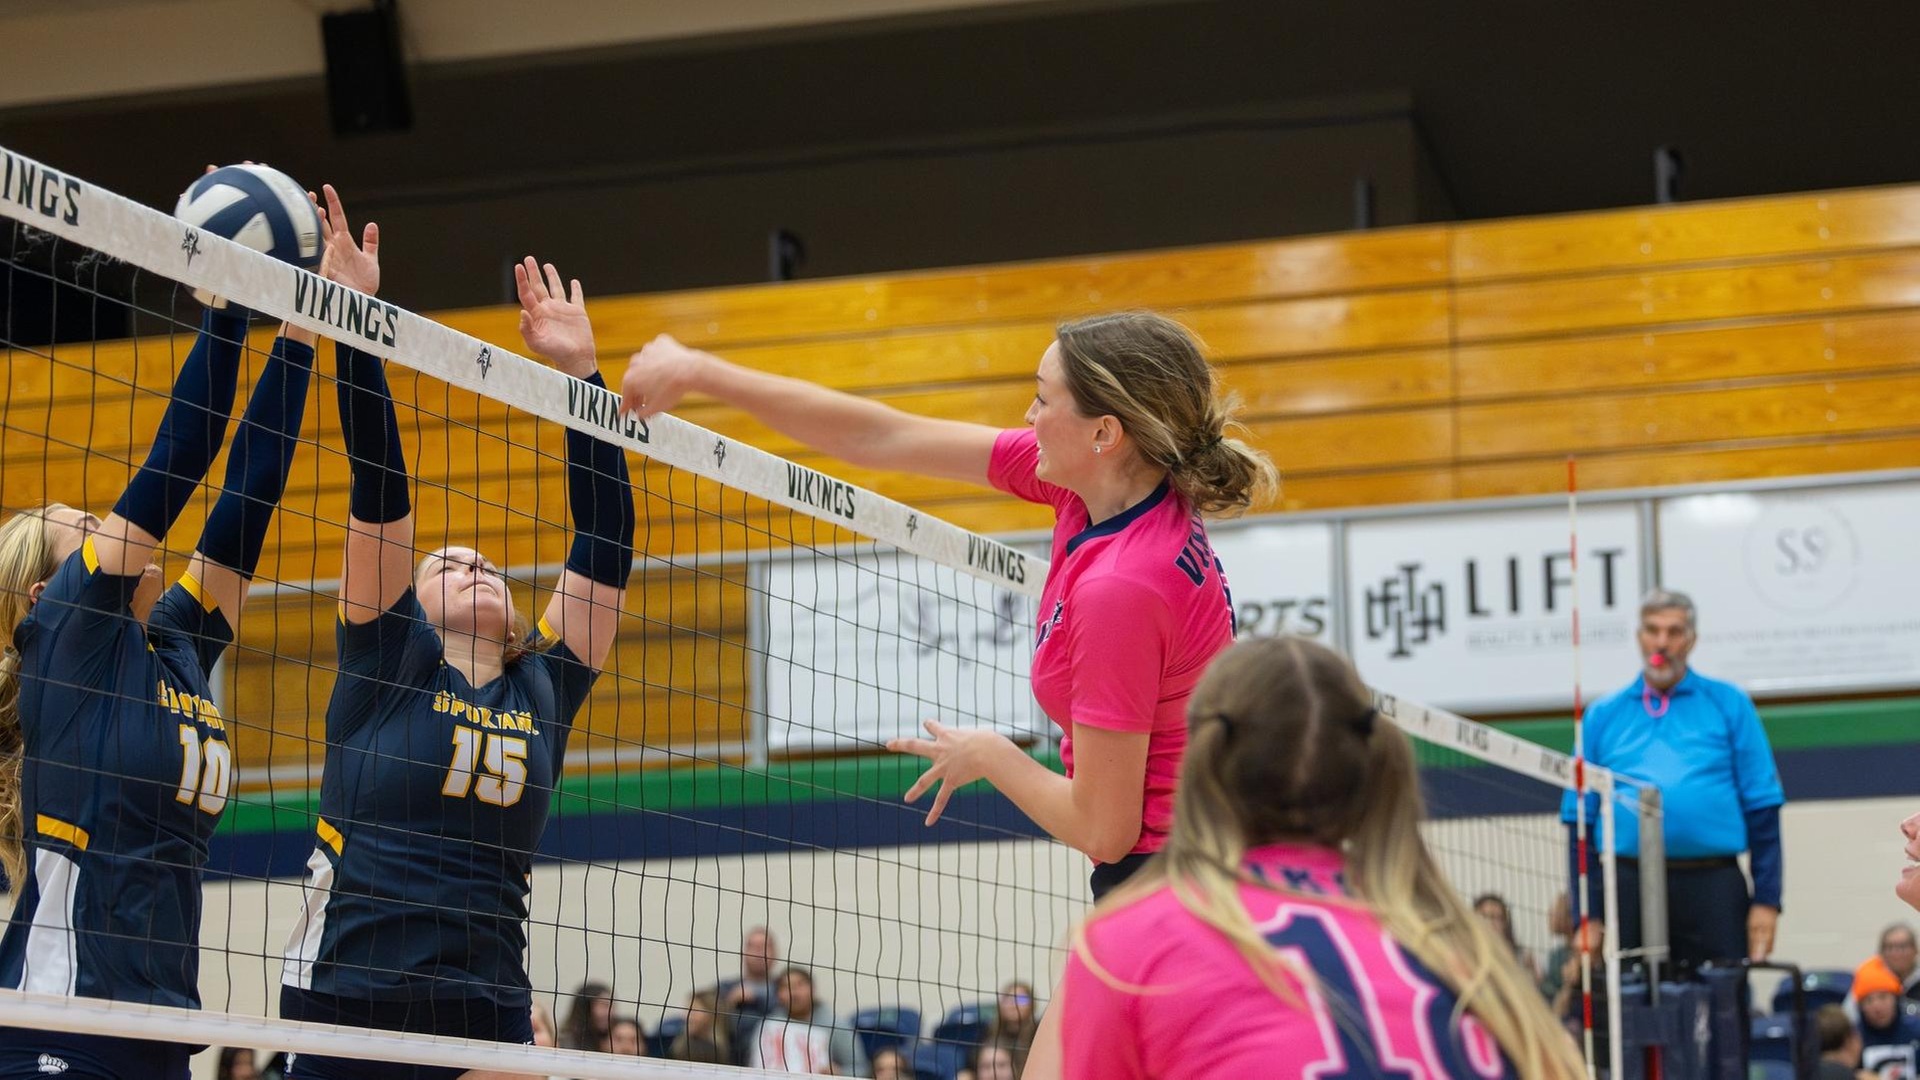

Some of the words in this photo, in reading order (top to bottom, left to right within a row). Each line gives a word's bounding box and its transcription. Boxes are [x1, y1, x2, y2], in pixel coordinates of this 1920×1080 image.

[0, 151, 81, 227] INGS
[294, 269, 399, 348] VIKINGS
[786, 462, 855, 520] VIKINGS
[967, 533, 1026, 585] VIKINGS
[1236, 598, 1326, 639] RTS
[1466, 547, 1624, 616] LIFT
[432, 690, 540, 736] SPOKAN
[175, 724, 231, 816] 10
[441, 724, 528, 808] 15
